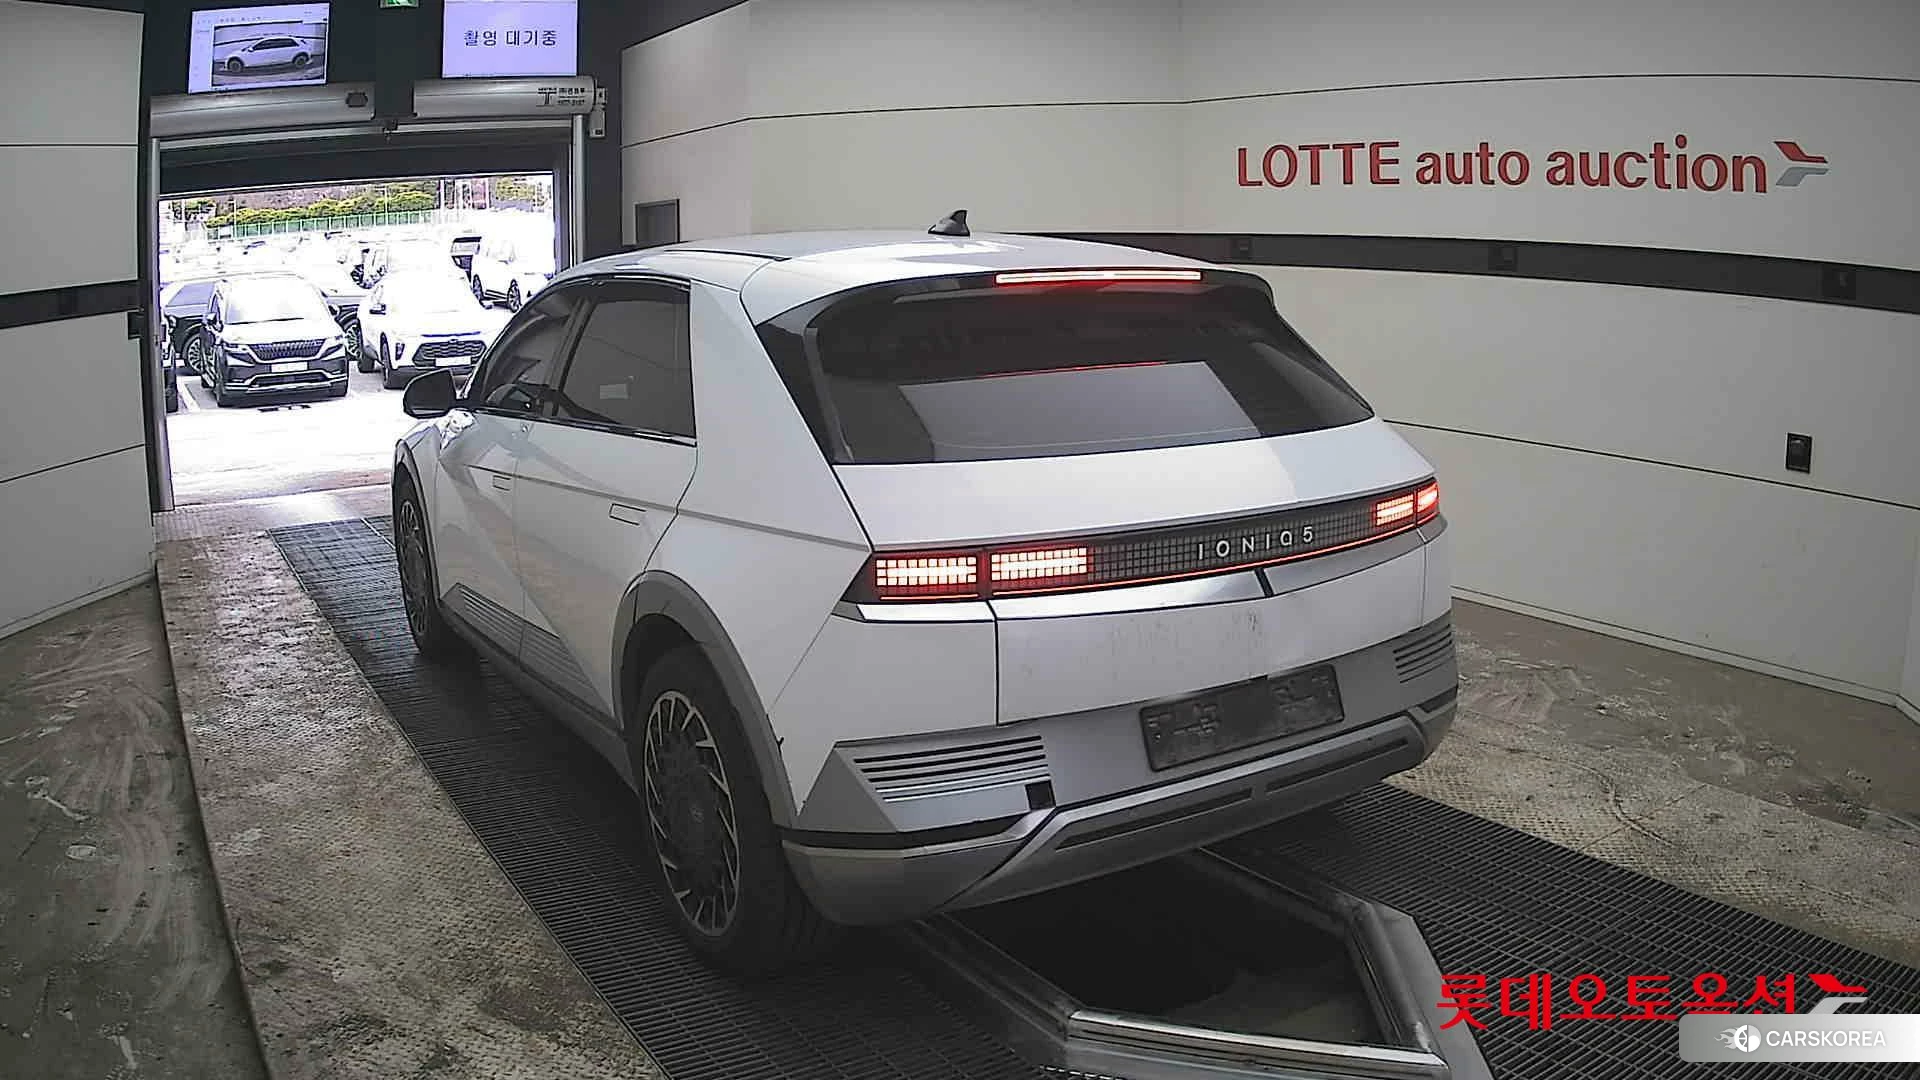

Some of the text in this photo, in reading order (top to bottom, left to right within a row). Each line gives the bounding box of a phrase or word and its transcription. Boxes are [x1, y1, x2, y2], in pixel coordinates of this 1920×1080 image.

[464, 30, 557, 46] 촬영 대기중
[1238, 134, 1767, 193] LOTTE auto auction
